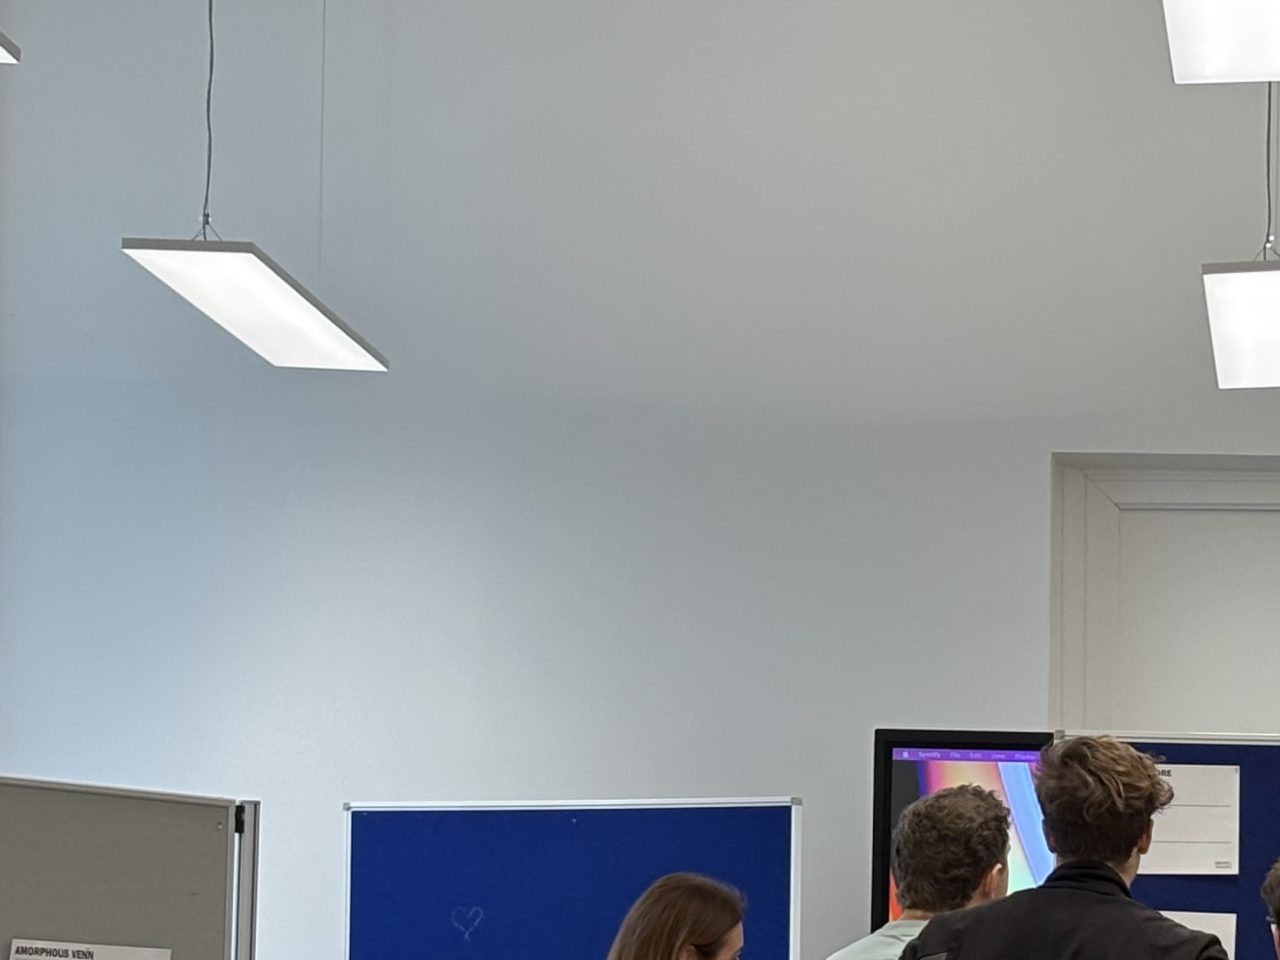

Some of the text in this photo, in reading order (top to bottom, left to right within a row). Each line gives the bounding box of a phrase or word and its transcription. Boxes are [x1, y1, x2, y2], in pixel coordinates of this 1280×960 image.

[918, 751, 941, 759] Spotify
[14, 945, 94, 960] AMORPHOUS VENN
